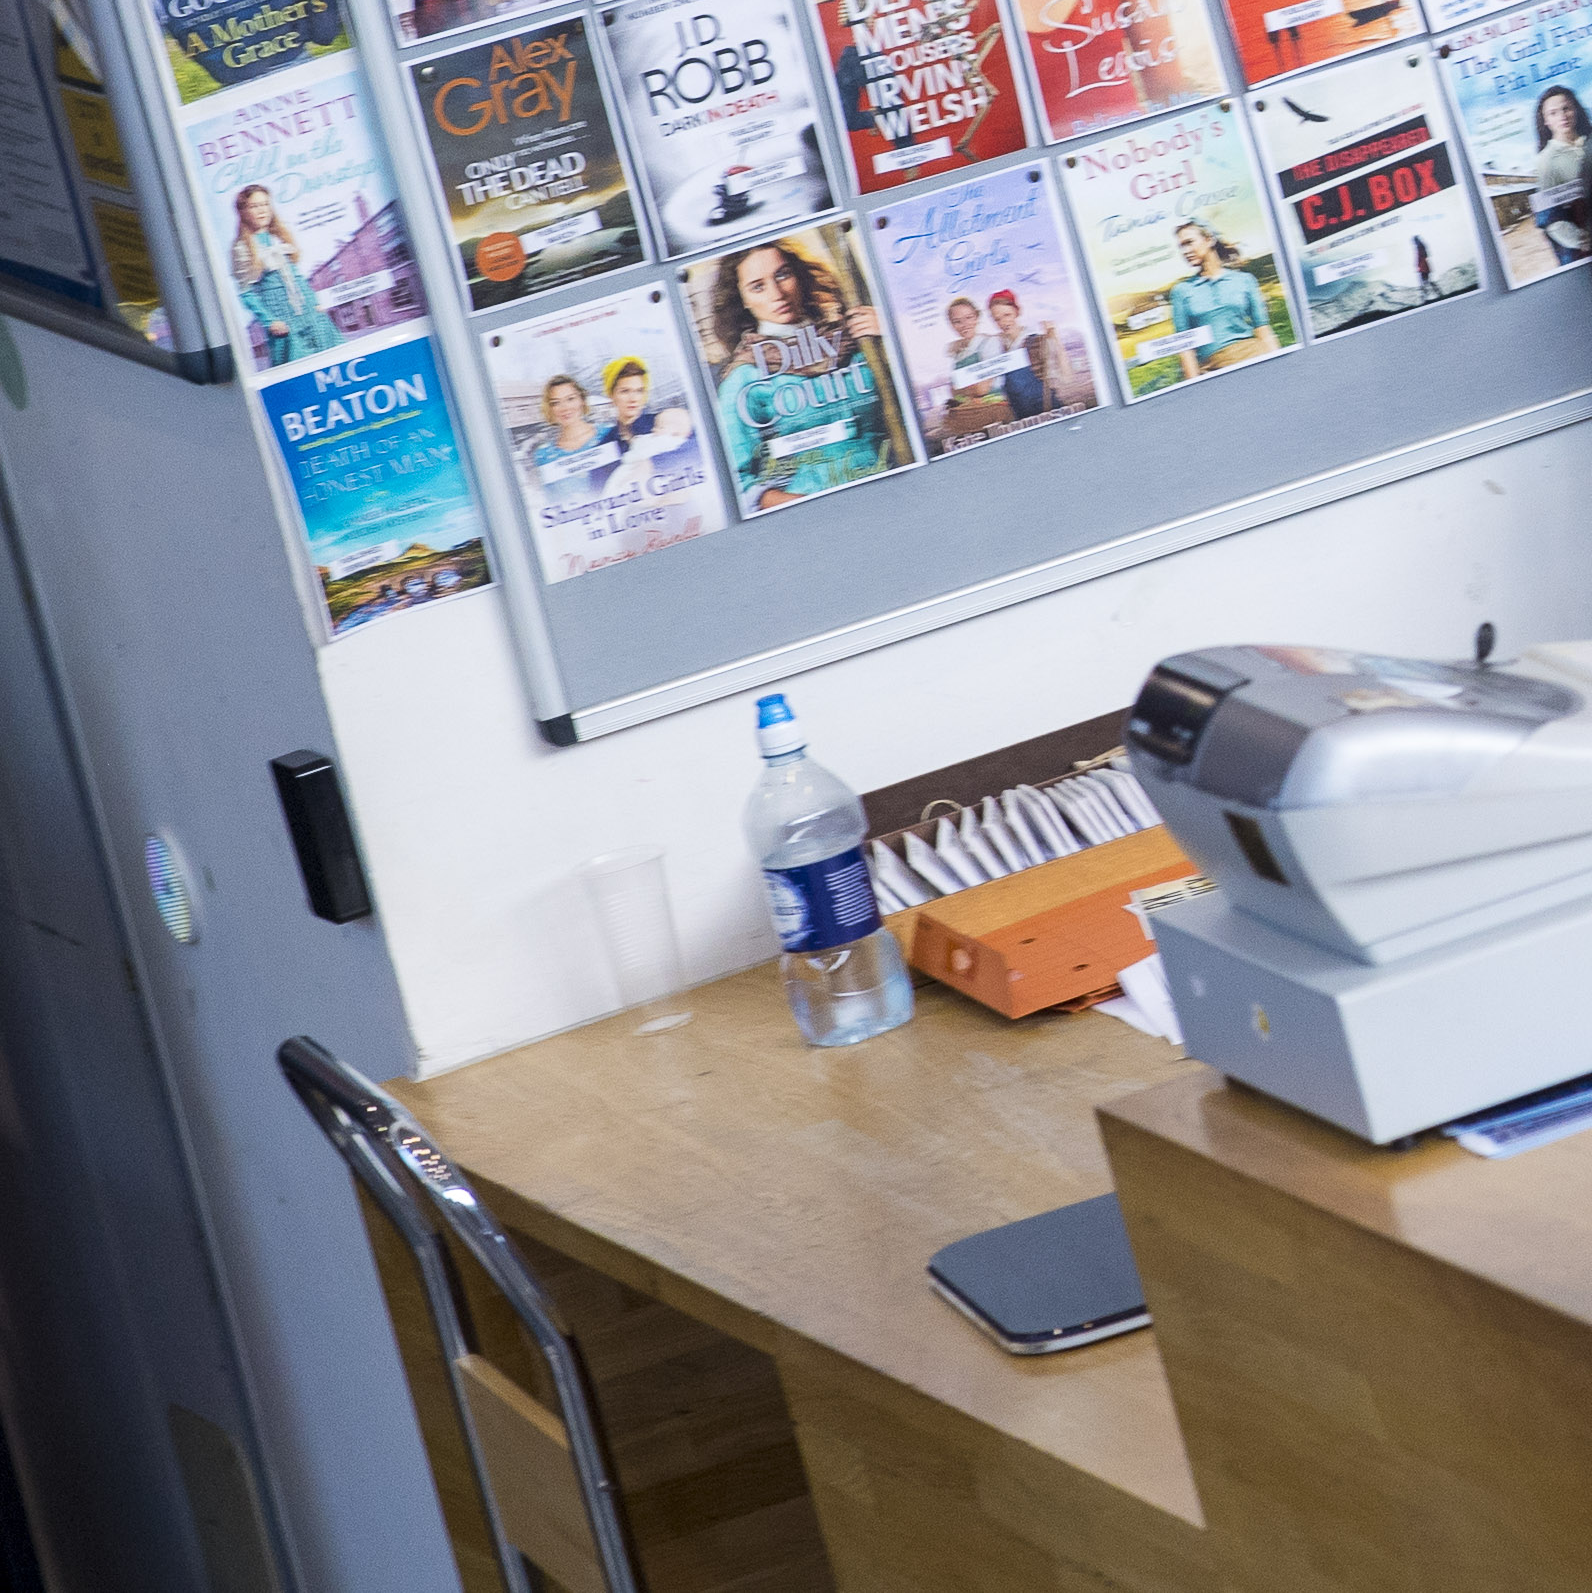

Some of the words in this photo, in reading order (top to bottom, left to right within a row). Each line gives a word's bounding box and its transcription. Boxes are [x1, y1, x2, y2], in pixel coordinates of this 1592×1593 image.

[185, 31, 208, 59] A
[222, 30, 301, 70] Grace
[487, 33, 575, 83] Alex
[860, 31, 976, 80] TROUSERS
[1061, 37, 1181, 99] Lewis
[1455, 50, 1496, 80] The
[1502, 34, 1547, 63] Girl
[1529, 54, 1582, 85] Lane
[432, 61, 577, 137] Gray
[641, 39, 776, 117] ROBB
[199, 94, 359, 166] BENNETT
[873, 86, 988, 141] WELSH
[464, 152, 517, 182] ONLY
[1081, 117, 1226, 182] Nobody's
[1291, 158, 1327, 182] THE
[456, 170, 512, 208] THE
[508, 150, 587, 193] DEAD
[1129, 160, 1198, 201] Girl
[1299, 189, 1366, 232] C.J.
[1367, 158, 1443, 212] BOX
[751, 325, 843, 380] Dilly
[281, 372, 428, 443] BEATON
[736, 361, 875, 429] Court
[540, 478, 643, 531] Shipyard
[645, 468, 707, 501] Girls
[608, 505, 665, 534] Love
